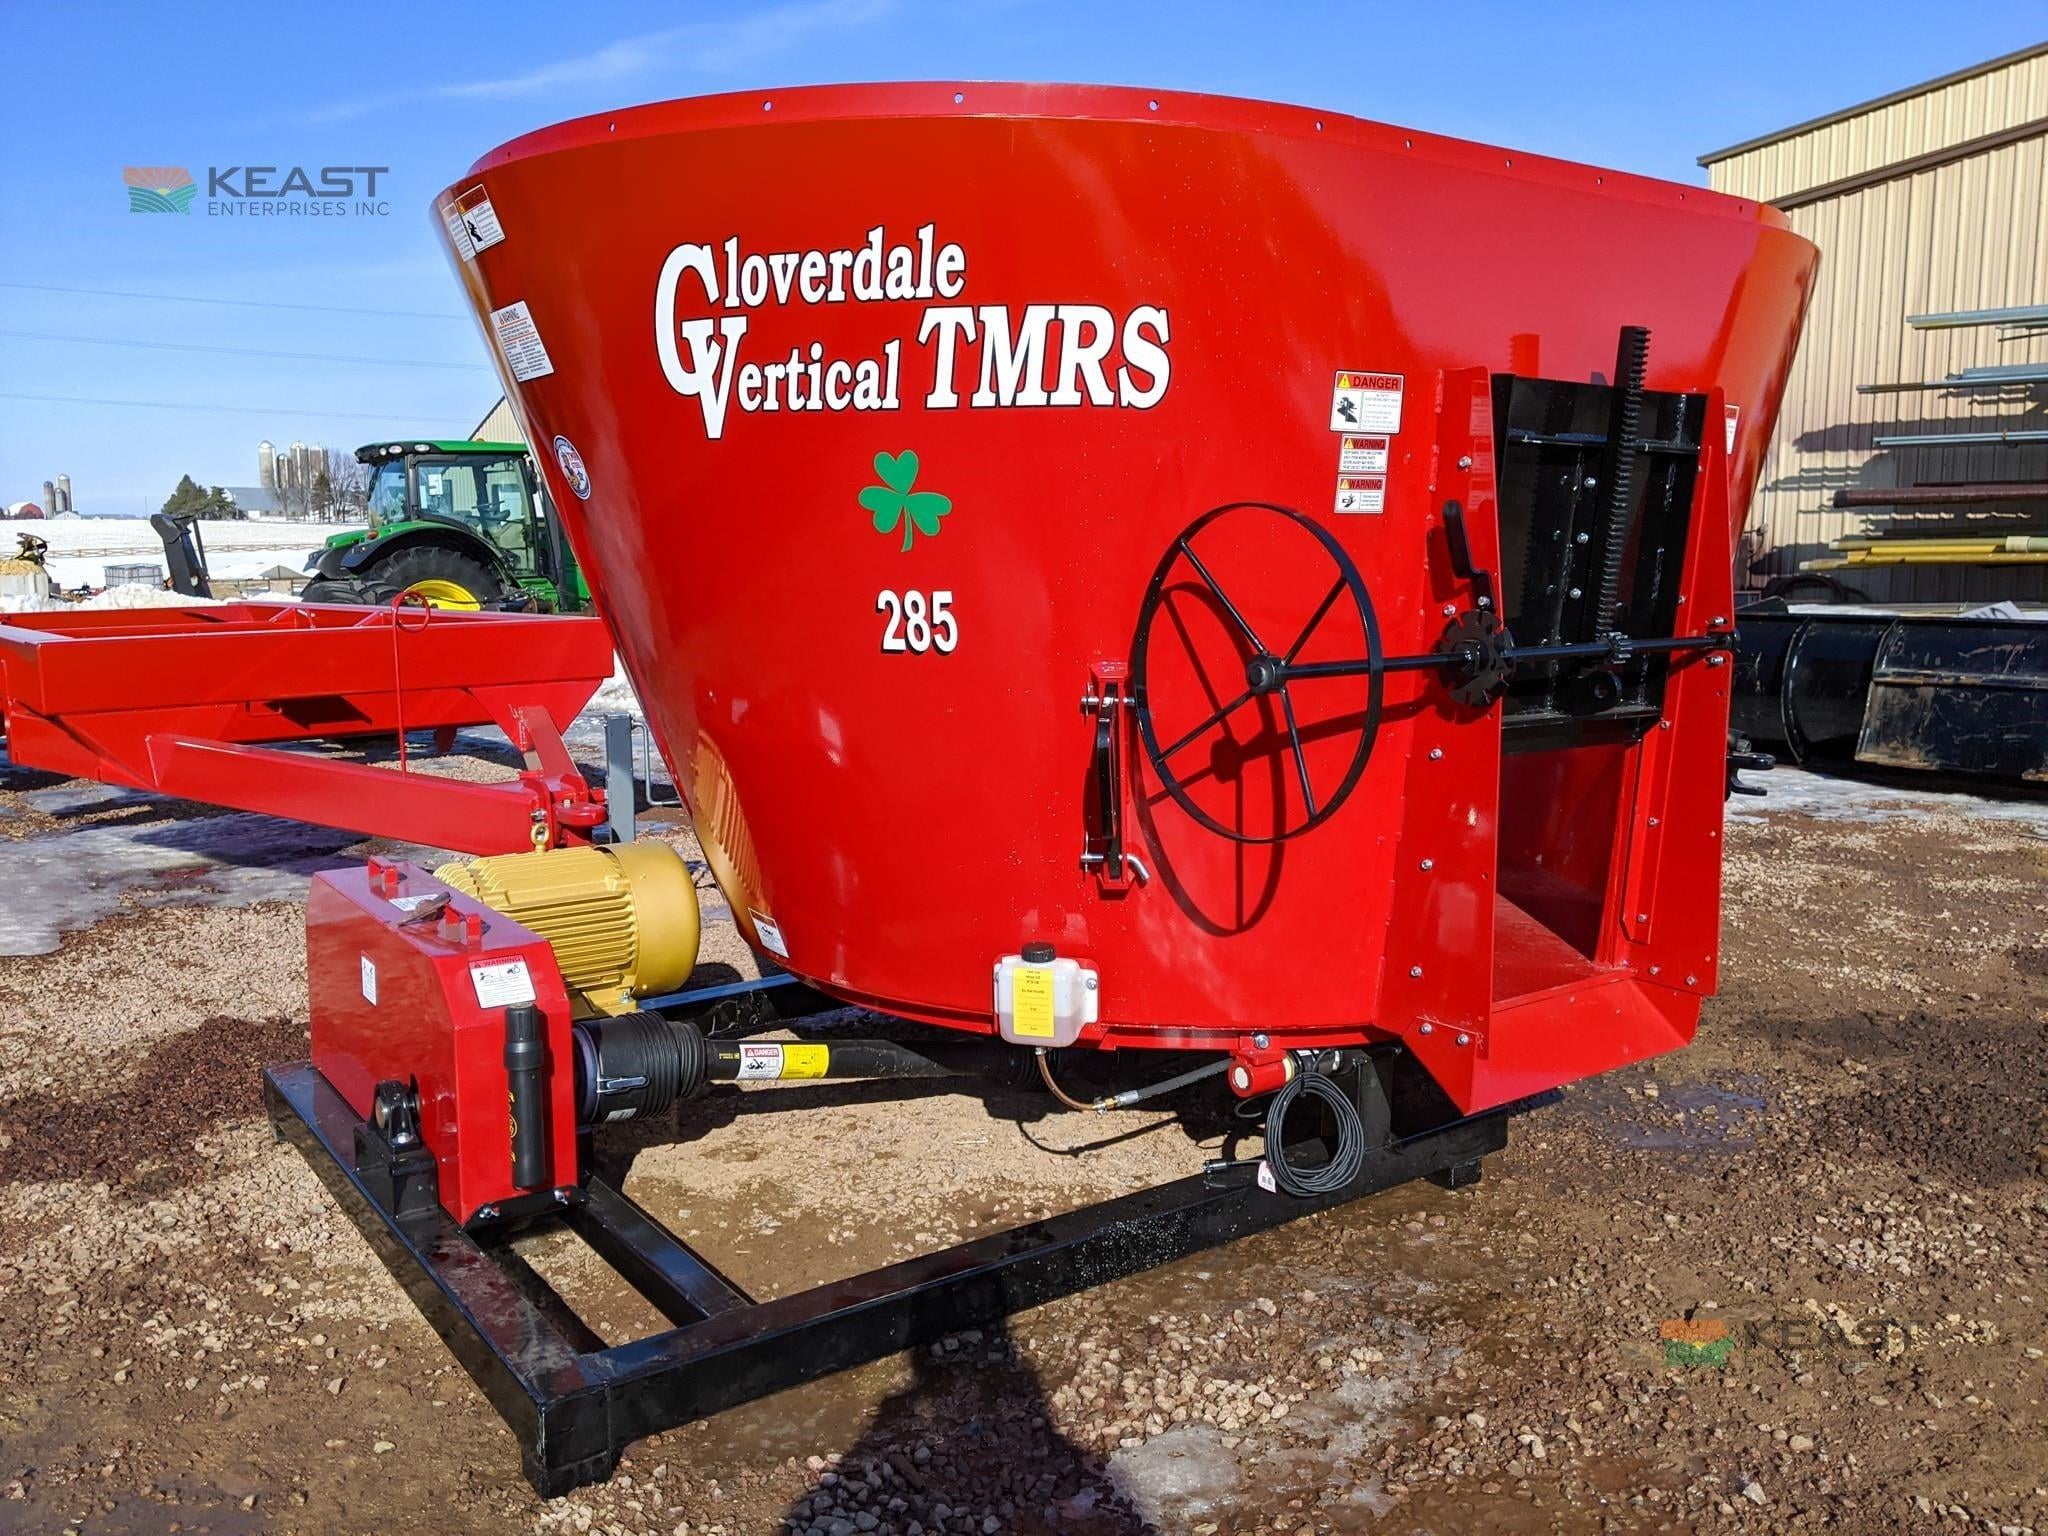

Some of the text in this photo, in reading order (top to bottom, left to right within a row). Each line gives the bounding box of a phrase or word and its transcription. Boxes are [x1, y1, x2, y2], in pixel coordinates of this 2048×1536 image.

[654, 223, 966, 397] Cloverdale
[680, 315, 901, 440] Vertical
[916, 304, 1171, 410] TMRS
[1353, 376, 1399, 390] DANGER
[1350, 479, 1382, 490] WARNING
[875, 588, 959, 656] 285
[484, 956, 521, 967] WARNING
[754, 1047, 779, 1057] DANGER
